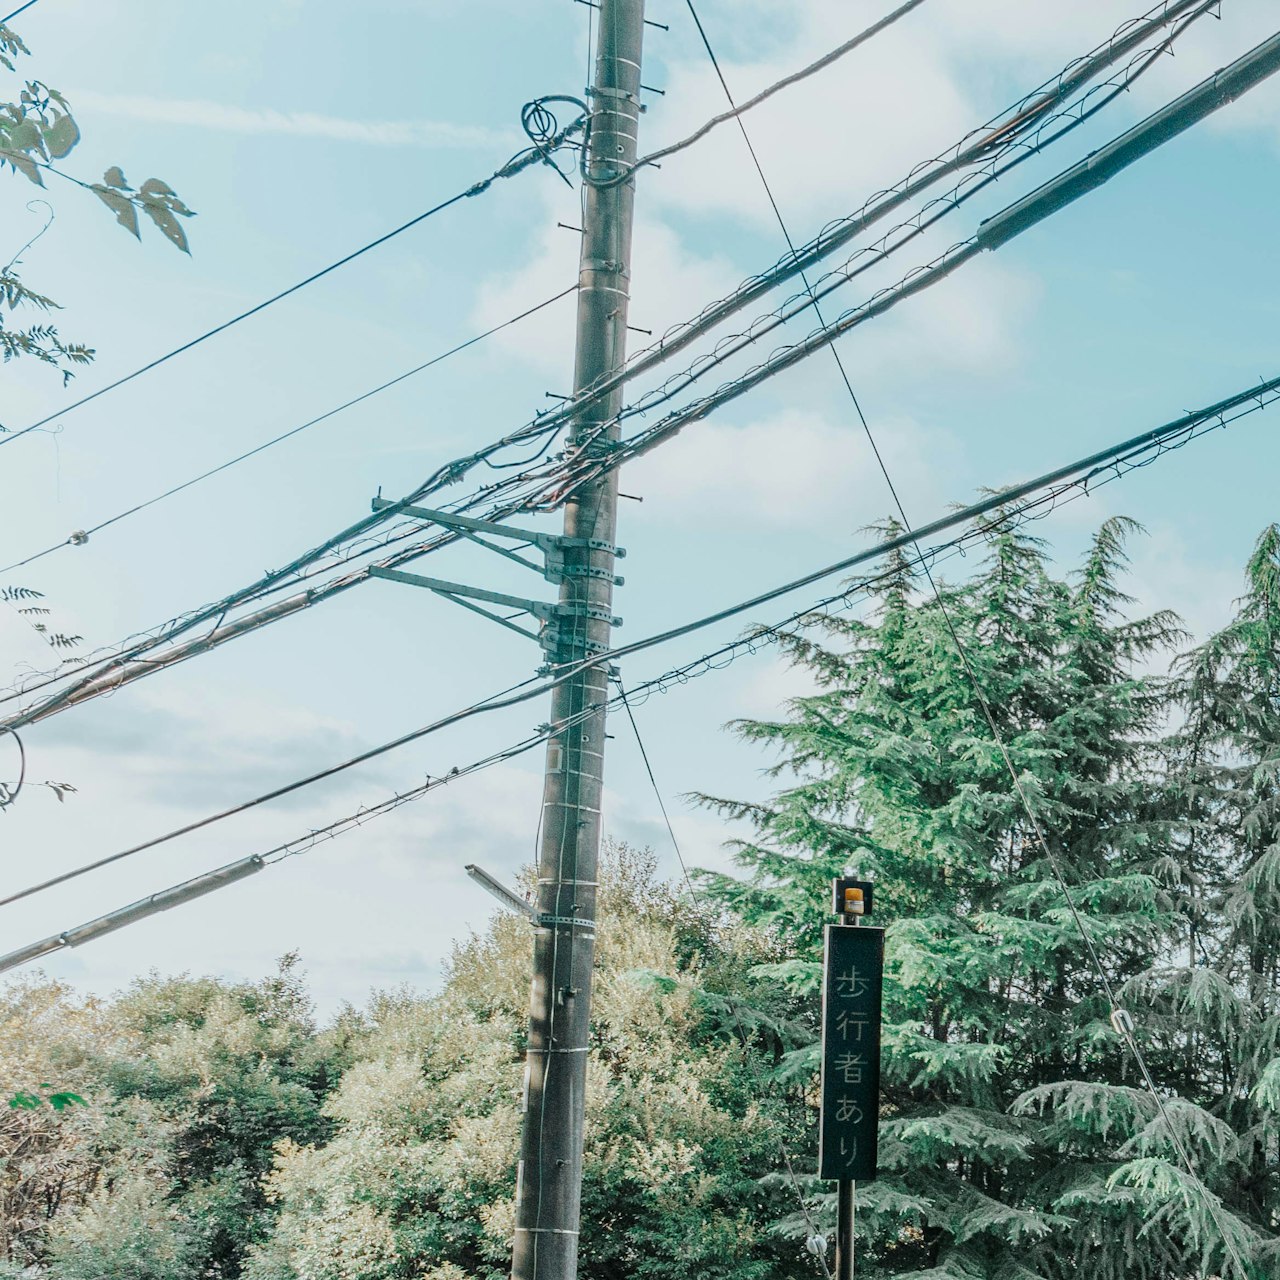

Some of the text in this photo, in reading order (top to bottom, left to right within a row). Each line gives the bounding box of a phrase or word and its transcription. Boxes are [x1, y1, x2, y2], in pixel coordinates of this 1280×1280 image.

[833, 965, 870, 1167] 歩行者あり
